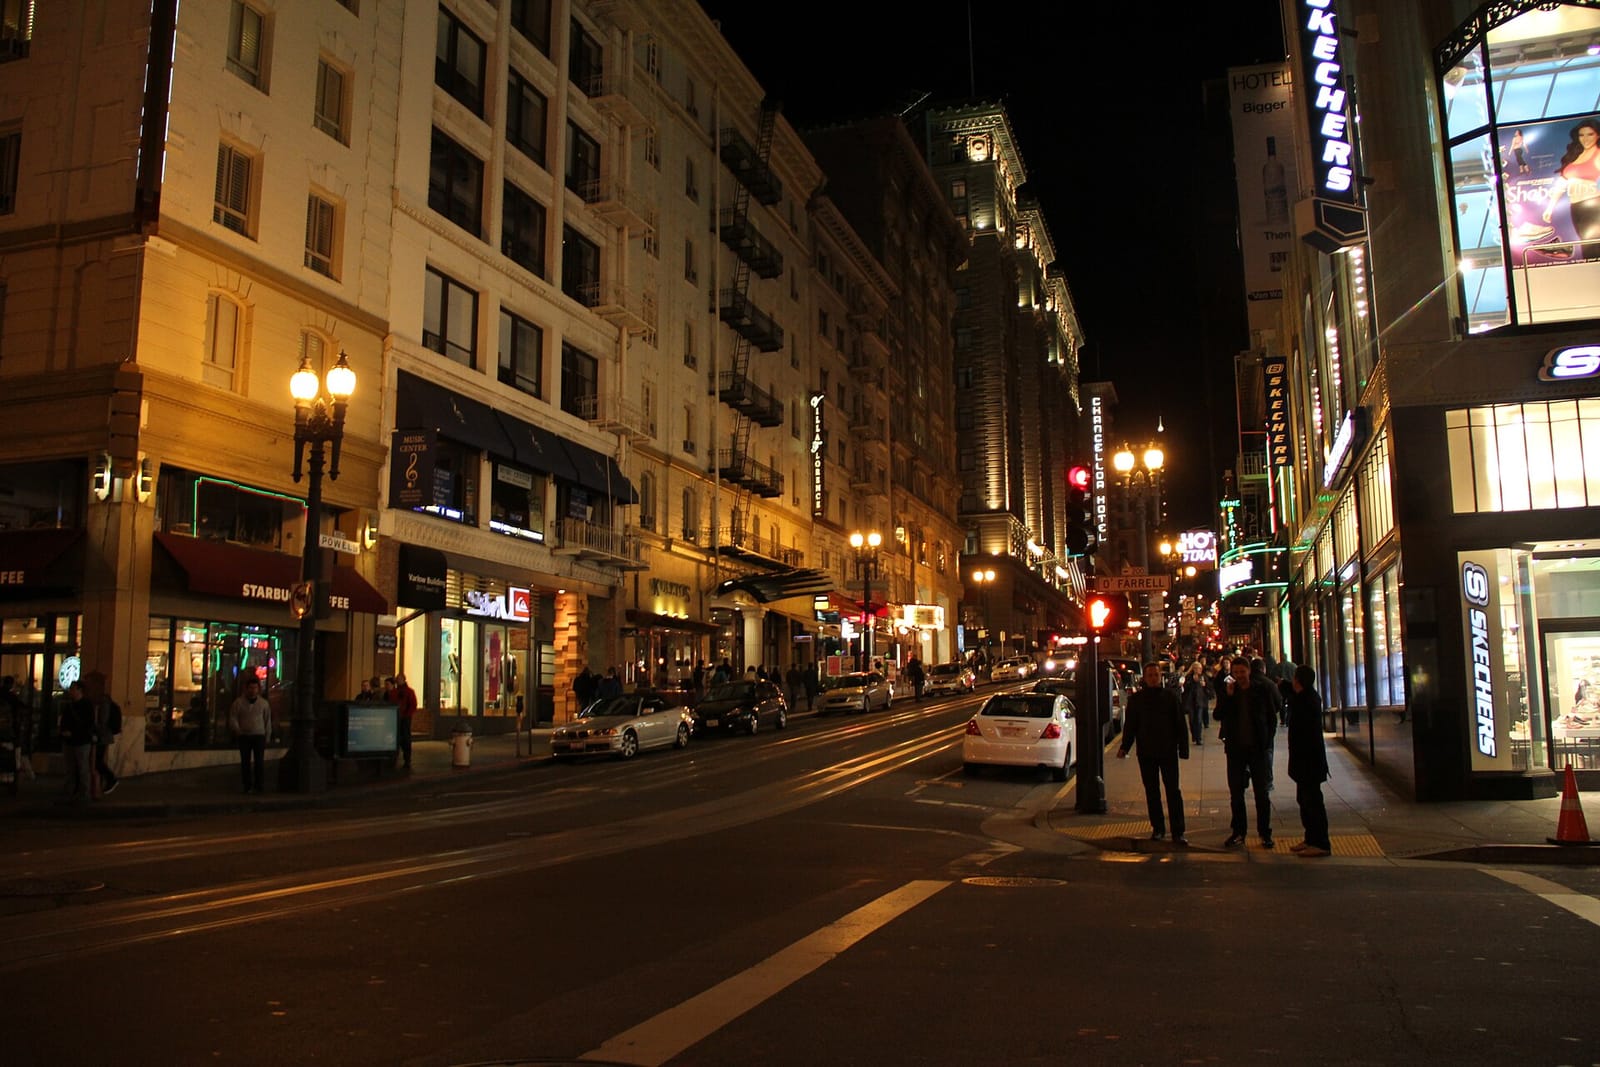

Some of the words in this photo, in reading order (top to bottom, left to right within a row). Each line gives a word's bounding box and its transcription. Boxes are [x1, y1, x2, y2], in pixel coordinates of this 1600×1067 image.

[1243, 101, 1287, 114] Bigger
[1269, 376, 1287, 465] SKECHERS
[1092, 397, 1105, 488] CHANCELLOR
[1219, 499, 1241, 508] WINE
[1097, 495, 1107, 541] HOTEL
[321, 536, 359, 553] POWELL
[0, 570, 25, 585] FEE
[242, 583, 290, 603] STARBU
[328, 596, 351, 610] FEE
[1469, 608, 1496, 758] SKECHERS
